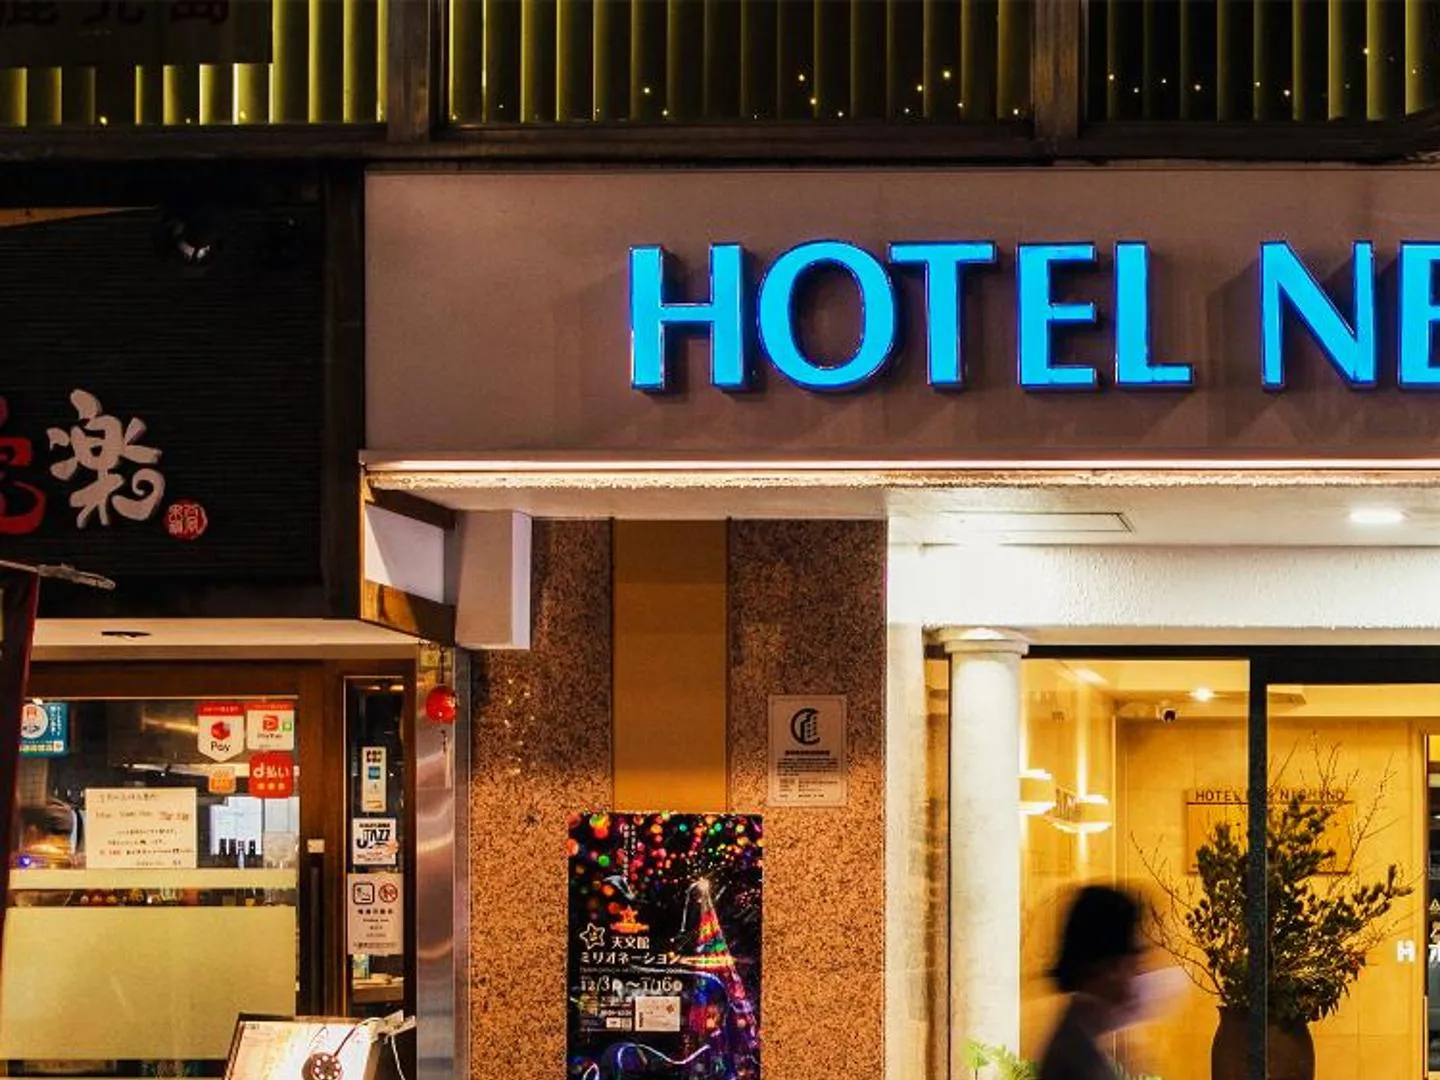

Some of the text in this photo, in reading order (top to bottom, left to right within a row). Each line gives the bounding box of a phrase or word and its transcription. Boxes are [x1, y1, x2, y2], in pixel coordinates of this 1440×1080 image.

[629, 239, 1195, 390] HOTEL
[612, 936, 650, 950] 天文館
[580, 952, 681, 965] ミリオネーション
